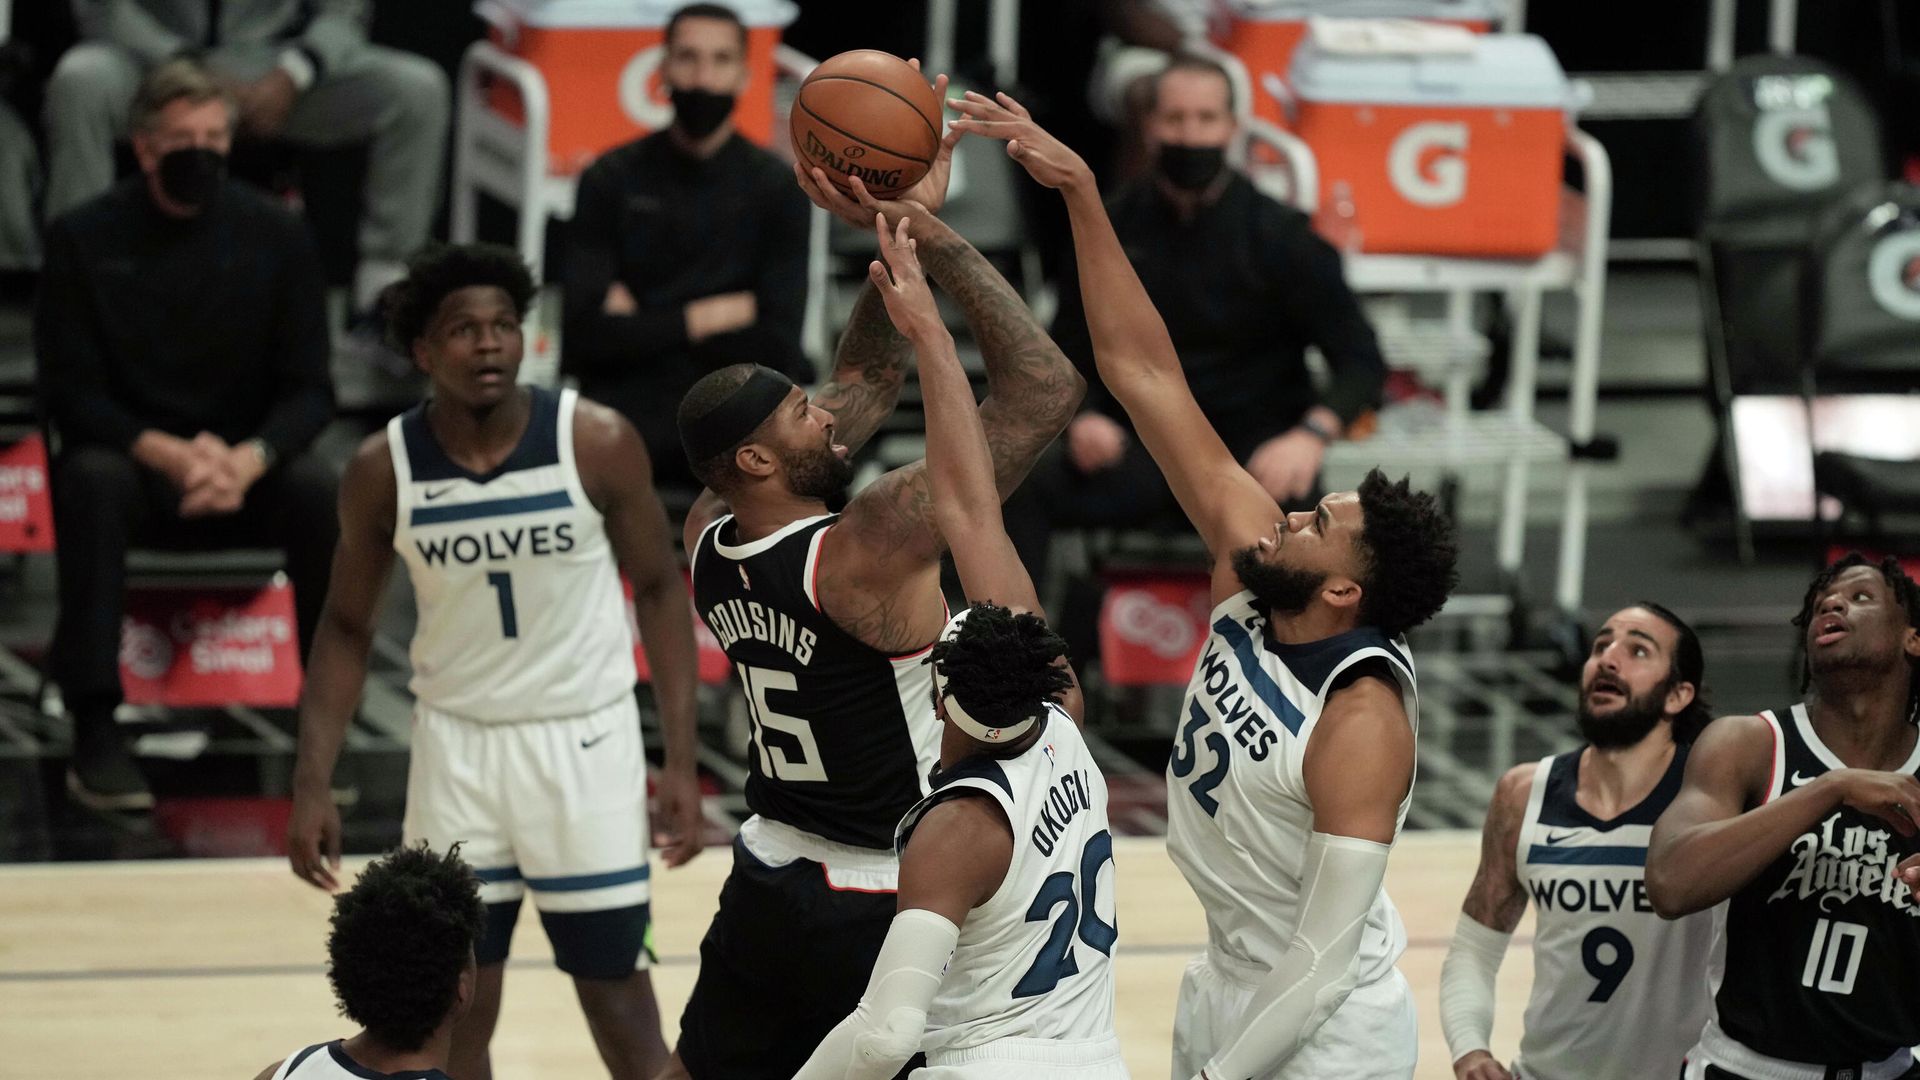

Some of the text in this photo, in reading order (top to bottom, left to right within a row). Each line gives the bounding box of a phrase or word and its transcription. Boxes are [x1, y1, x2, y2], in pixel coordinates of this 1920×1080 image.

[803, 130, 902, 188] SPALDING
[1385, 120, 1469, 208] G
[415, 523, 574, 567] WOLVES
[487, 571, 518, 639] 1
[708, 599, 817, 666] COUSINS
[736, 661, 829, 782] 15
[1199, 641, 1278, 762] WOLVES
[1171, 694, 1231, 819] 32
[1817, 812, 1891, 865] Los
[1011, 829, 1118, 999] 20
[1529, 879, 1656, 912] WOLVE
[1581, 926, 1634, 1003] 9
[1801, 918, 1868, 995] 10
